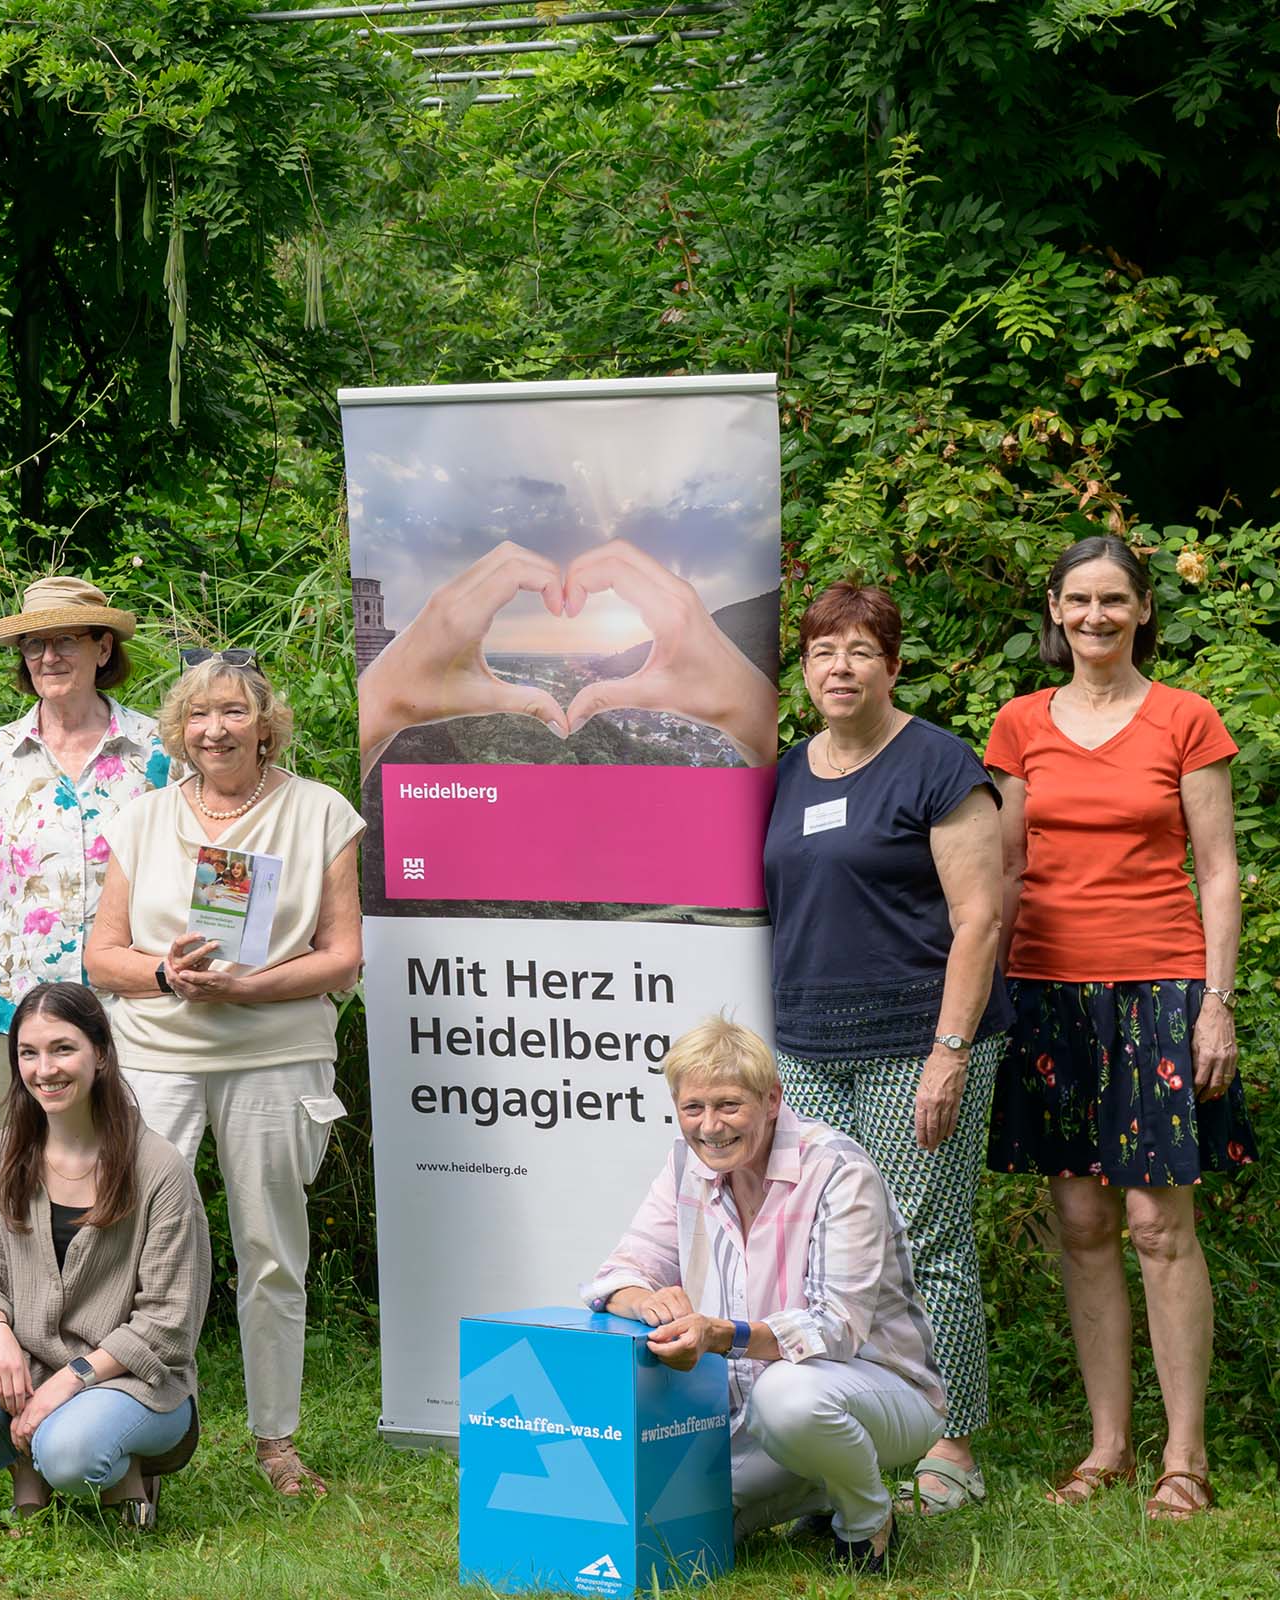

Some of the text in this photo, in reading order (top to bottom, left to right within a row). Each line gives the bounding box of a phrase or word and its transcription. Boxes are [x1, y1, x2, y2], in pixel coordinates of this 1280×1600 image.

[400, 783, 497, 803] Heidelberg
[407, 957, 674, 1003] Mit Herz in
[409, 1016, 671, 1074] Heidelberg
[409, 1079, 645, 1129] engagiert
[416, 1161, 527, 1177] www.heidelberg.de
[468, 1411, 623, 1442] wir-schaffen-was.de
[641, 1414, 727, 1444] #wirschaffenwas
